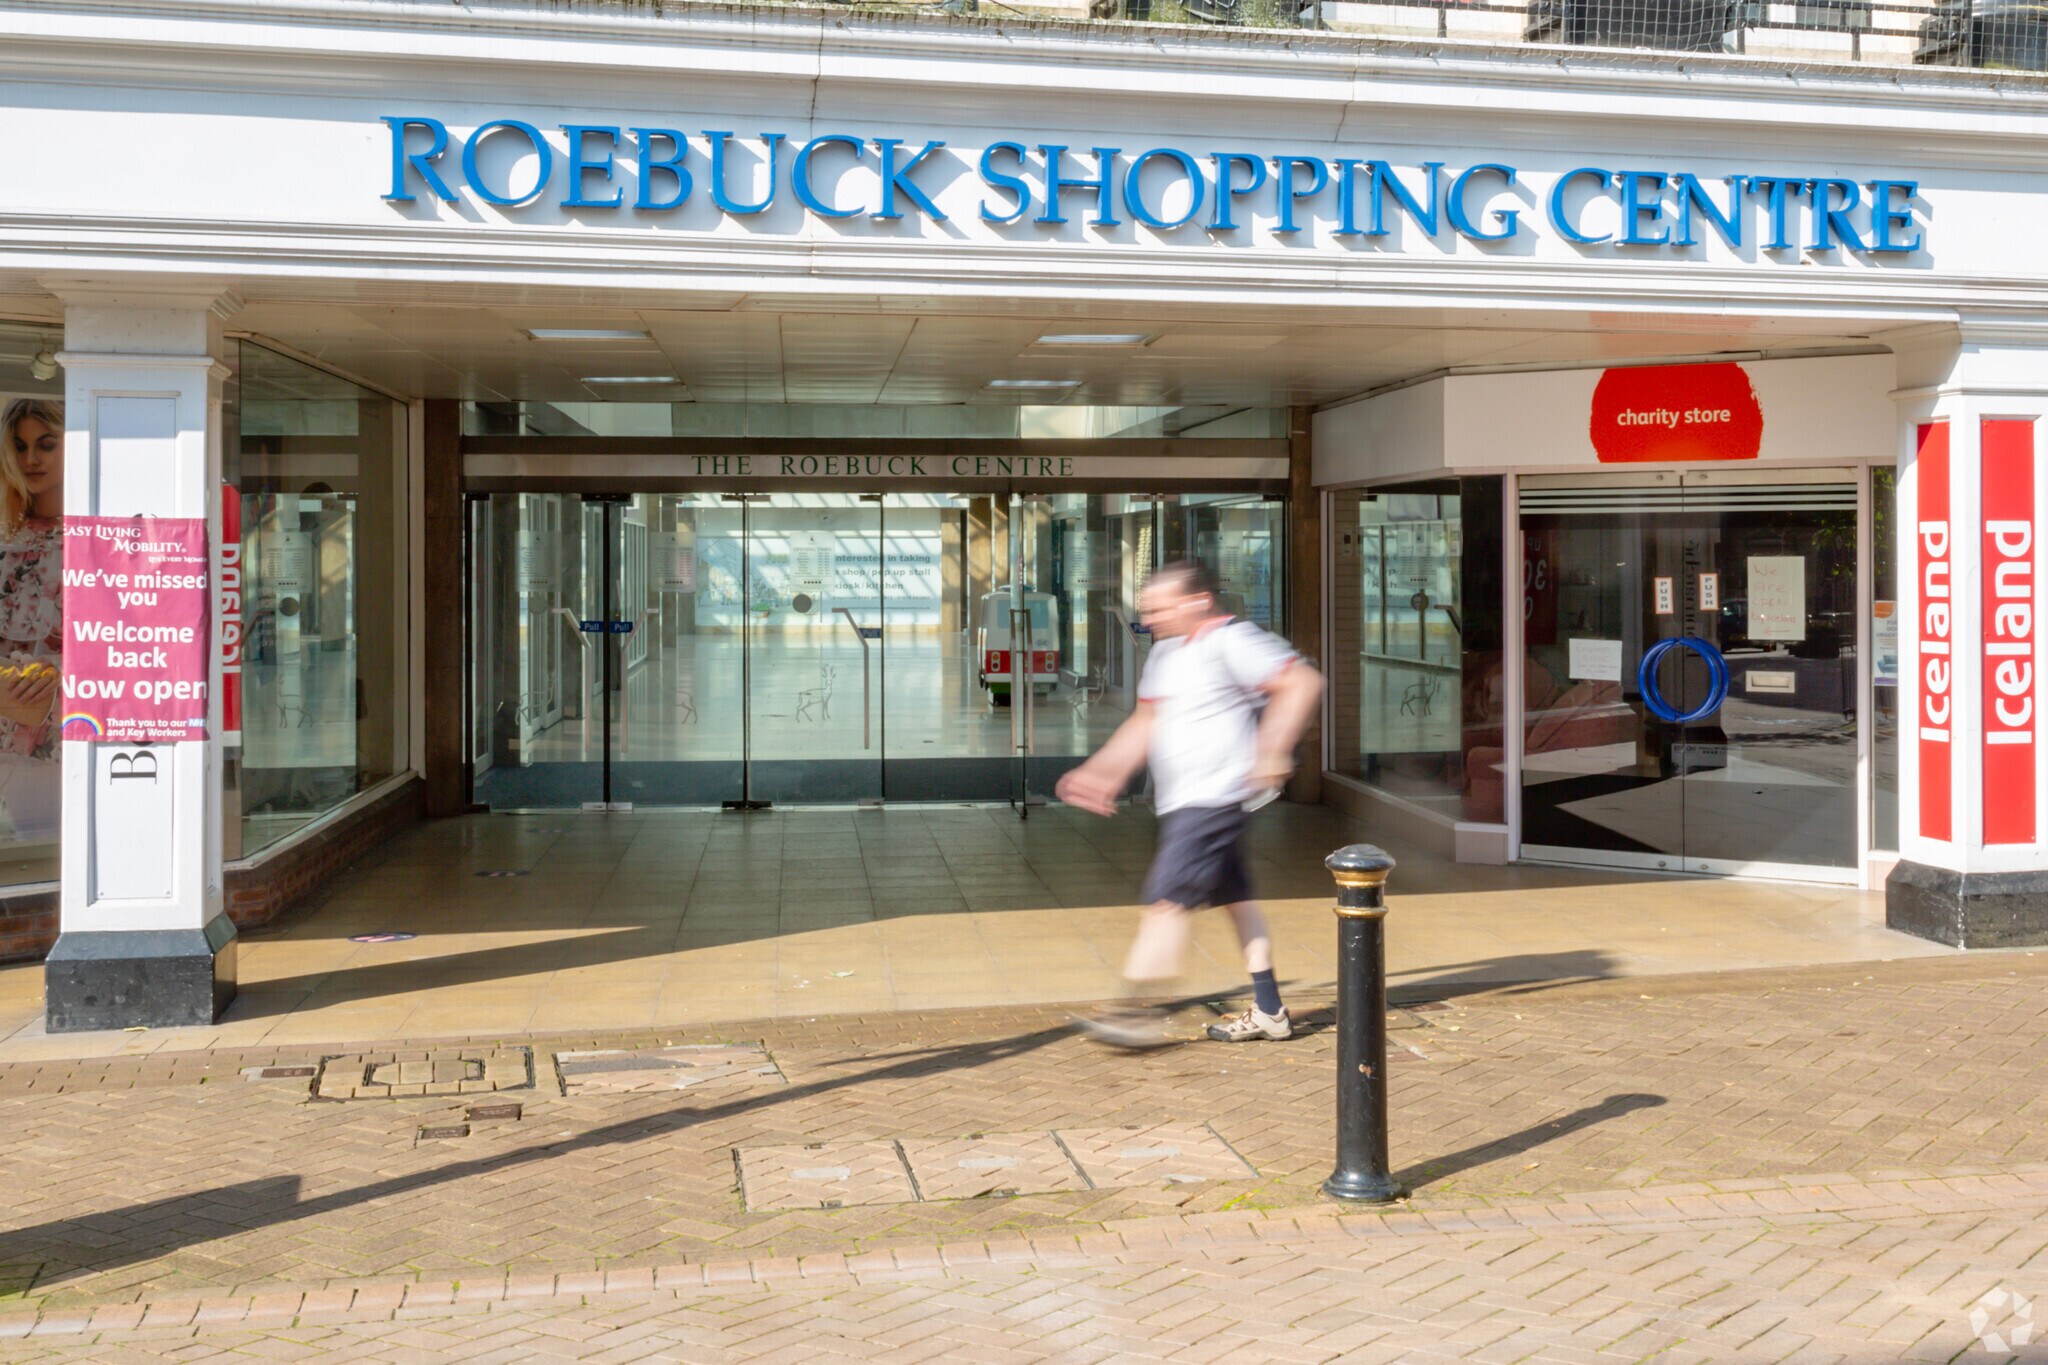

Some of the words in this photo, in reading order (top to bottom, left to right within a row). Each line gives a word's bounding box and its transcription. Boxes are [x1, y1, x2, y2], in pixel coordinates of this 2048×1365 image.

[380, 116, 949, 222] ROEBUCK
[978, 141, 1523, 242] SHOPPING
[1548, 167, 1922, 254] CENTRE
[1617, 408, 1680, 429] charity
[1684, 407, 1731, 424] store
[691, 455, 752, 476] THE
[780, 455, 928, 477] ROEBUCK
[952, 456, 1074, 477] CENTRE
[899, 554, 931, 563] taking
[134, 570, 207, 589] missed
[909, 568, 931, 576] stall
[118, 590, 157, 609] you
[1660, 581, 1669, 609] PUSH
[1705, 577, 1713, 606] PUSH
[73, 621, 194, 643] Welcome
[584, 622, 599, 631] Pull
[614, 623, 629, 631] Pull
[1919, 520, 1950, 743] Iceland
[1986, 520, 2033, 745] Iceland
[107, 646, 167, 668] back
[62, 674, 126, 699] Now
[134, 680, 207, 705] open
[106, 718, 136, 728] Thank
[138, 720, 156, 730] you
[157, 719, 168, 728] to
[170, 720, 187, 728] our
[107, 727, 125, 737] and
[127, 727, 146, 739] Key
[147, 727, 187, 737] Workers
